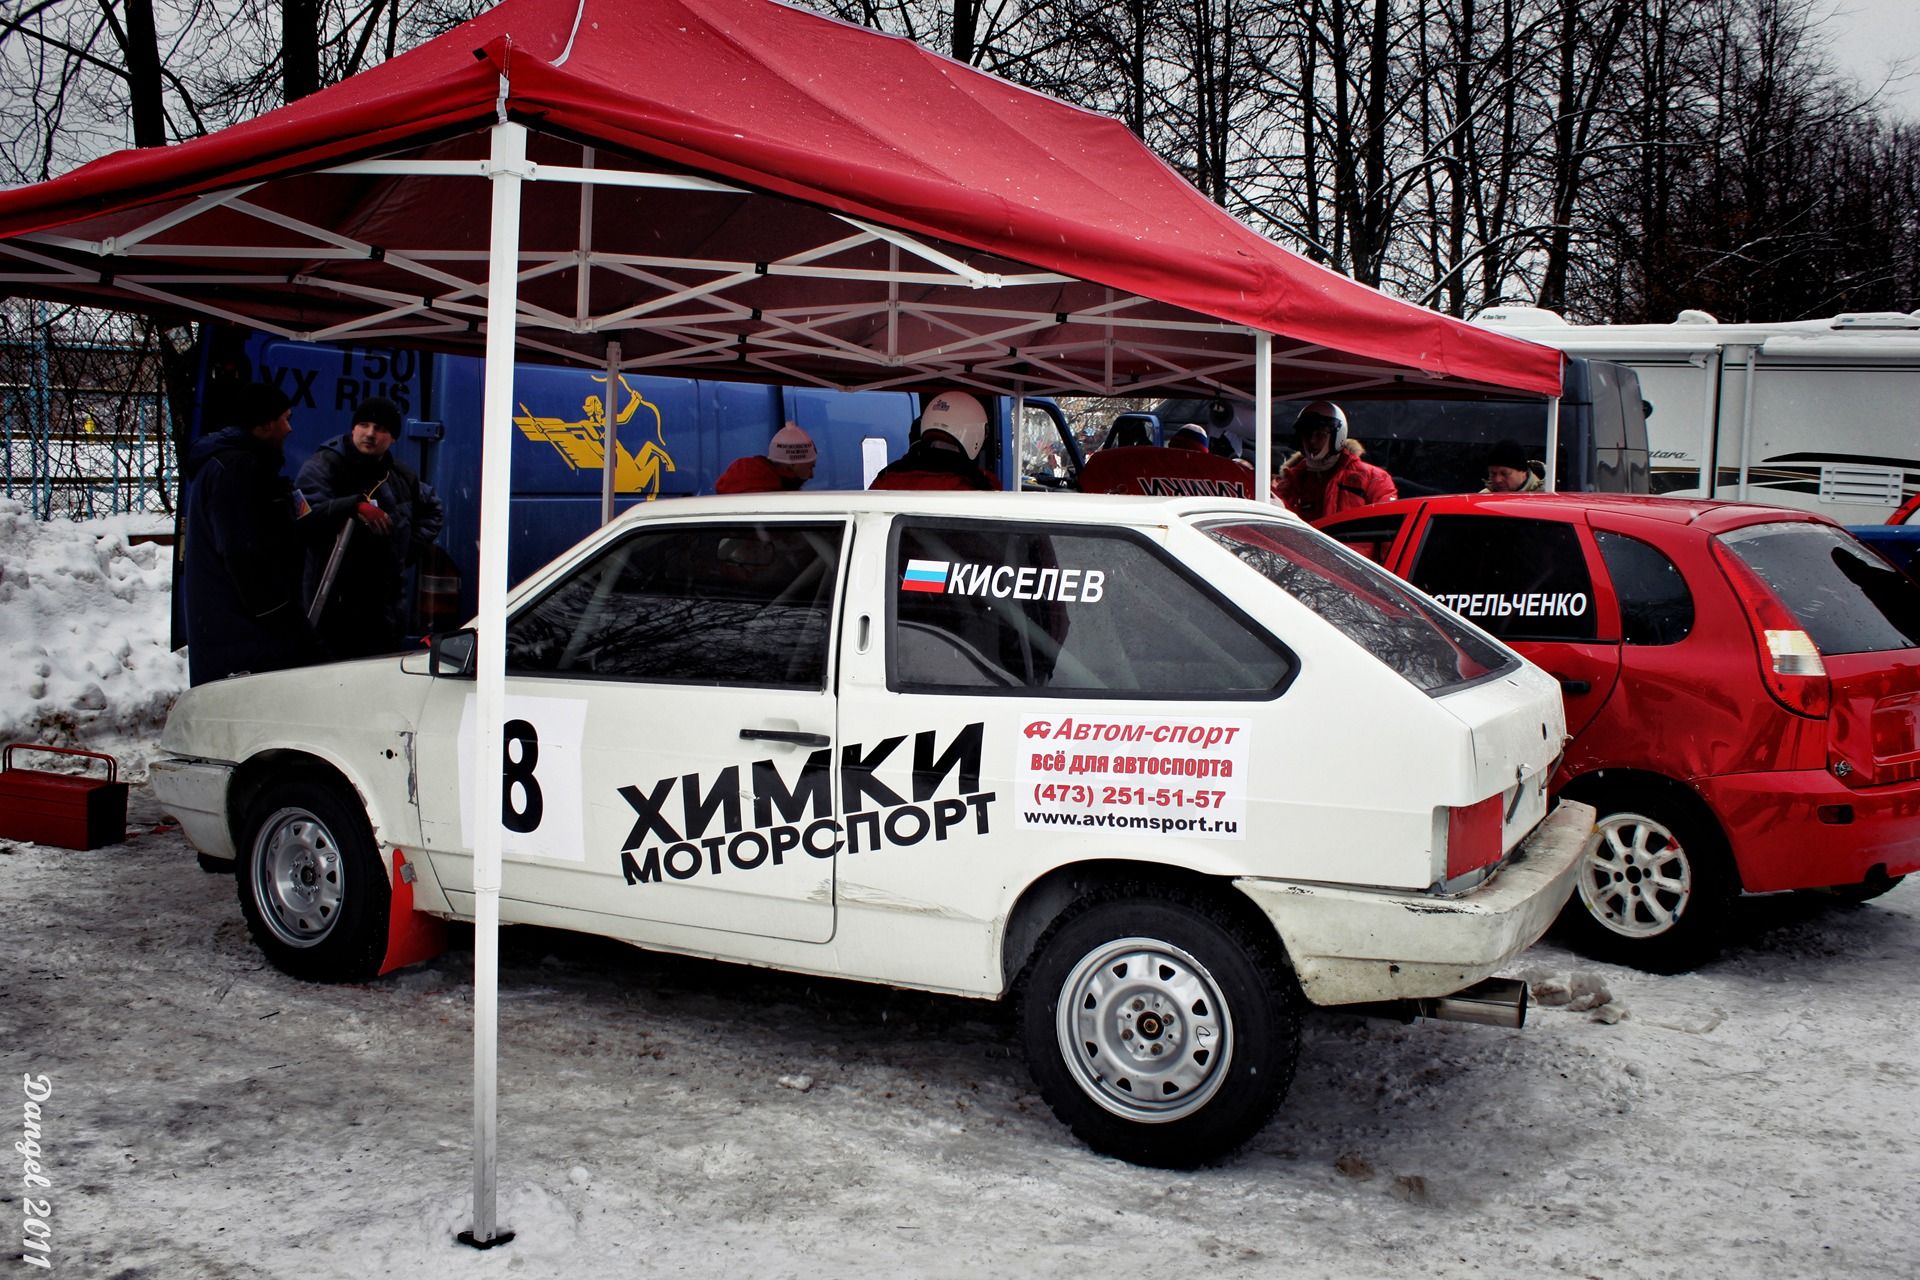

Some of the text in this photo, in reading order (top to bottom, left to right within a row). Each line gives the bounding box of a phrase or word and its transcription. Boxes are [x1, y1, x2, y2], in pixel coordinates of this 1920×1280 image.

[947, 563, 1104, 603] КИСЕЛЕВ
[502, 719, 543, 833] 8
[1031, 750, 1233, 778] всё для автоспорта
[616, 722, 985, 851] ХИМКИ
[1034, 784, 1226, 808] (473) 251-51-57
[620, 792, 996, 885] МОТОРСПОРТ
[1024, 811, 1237, 833] www.avtomsport.ru
